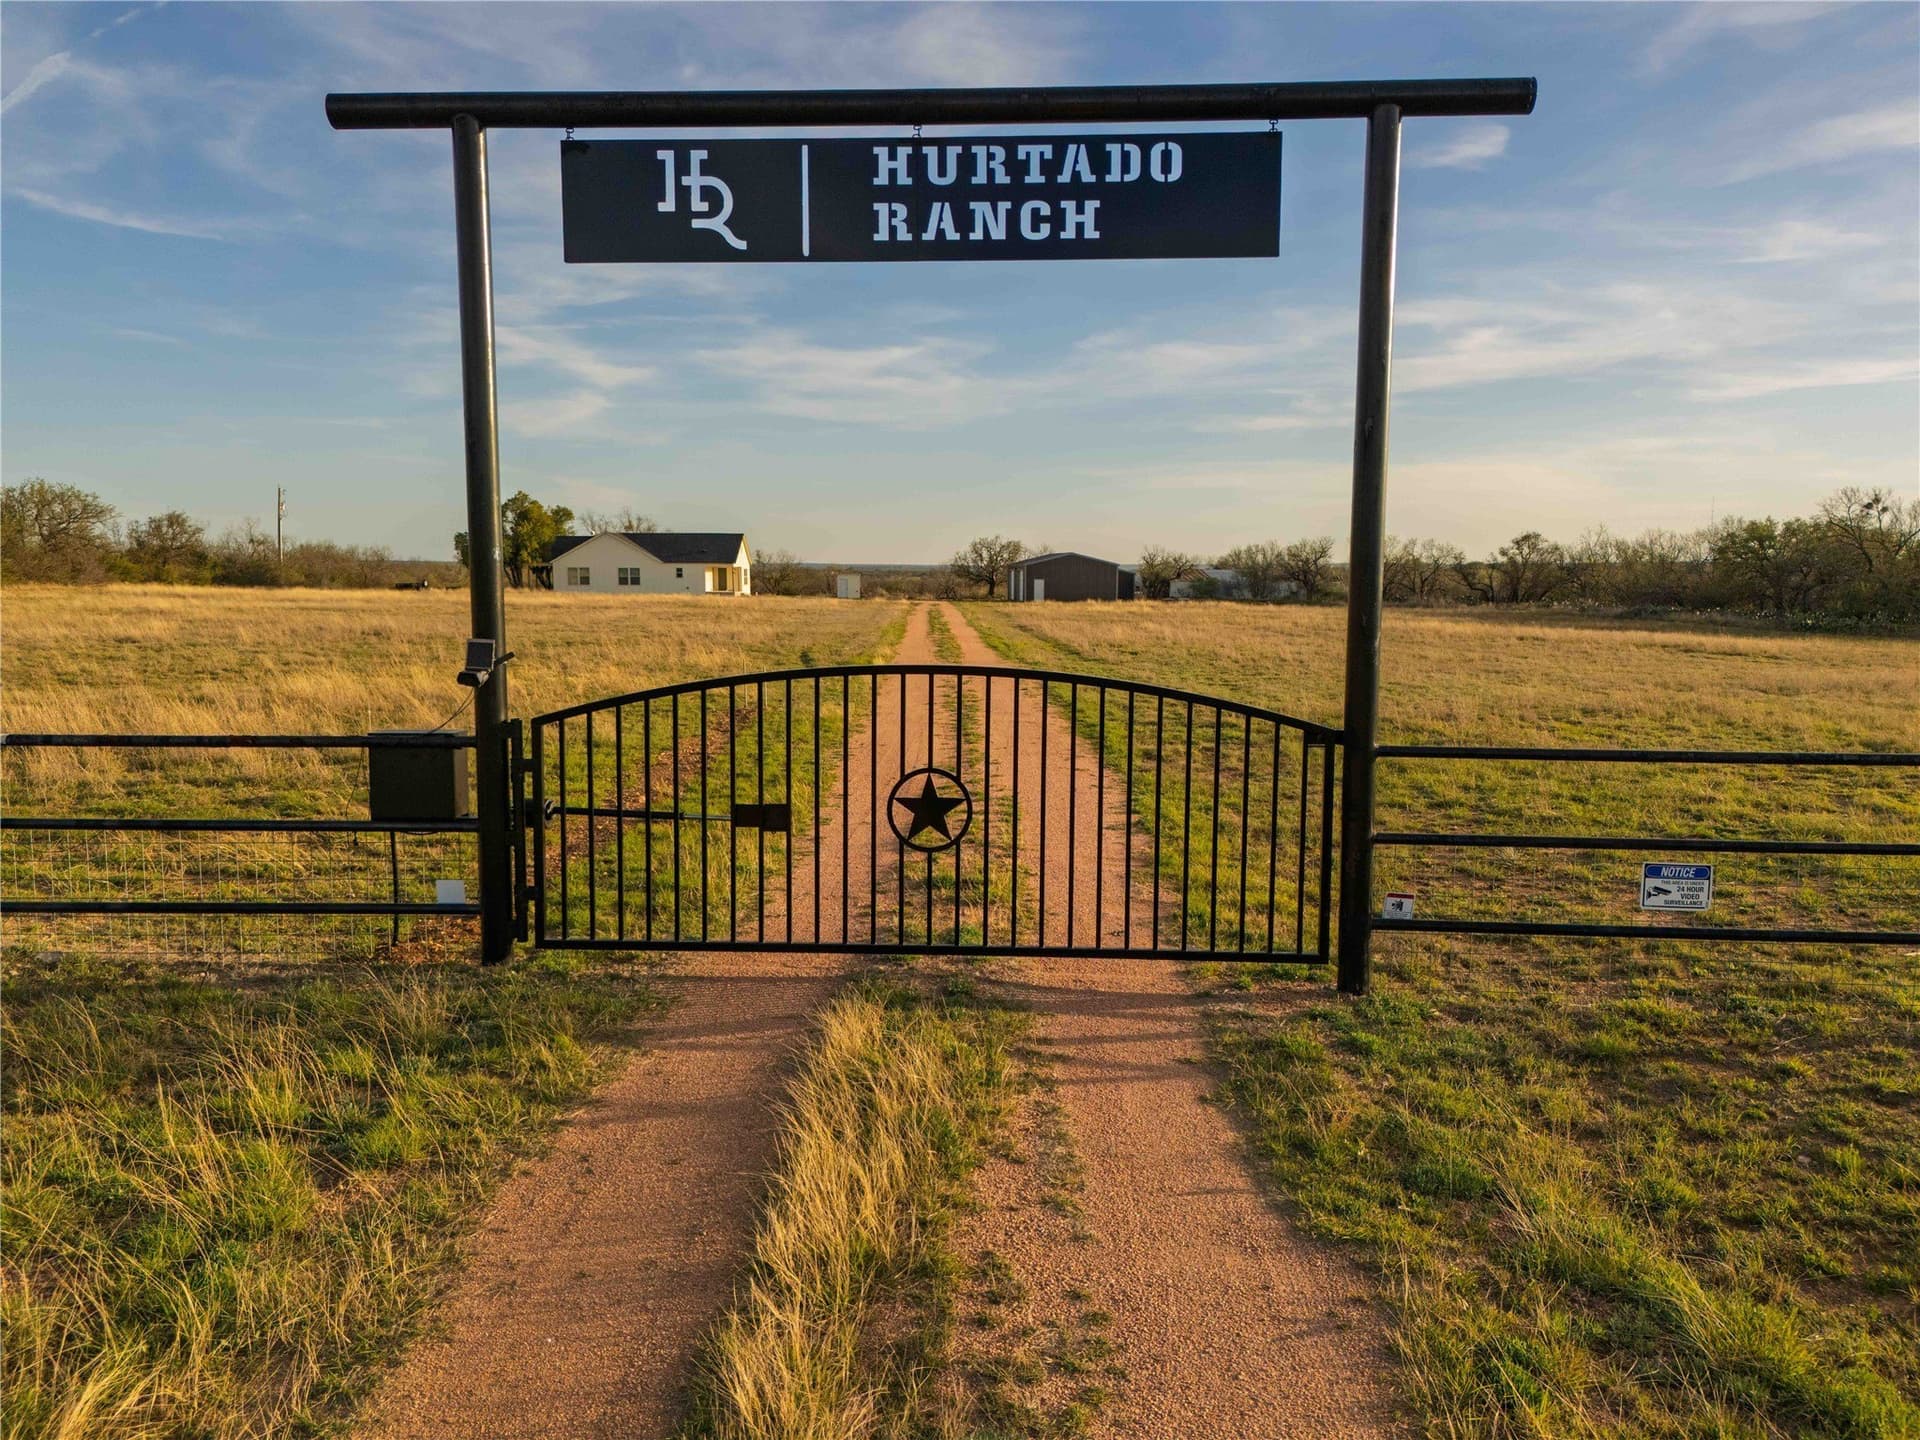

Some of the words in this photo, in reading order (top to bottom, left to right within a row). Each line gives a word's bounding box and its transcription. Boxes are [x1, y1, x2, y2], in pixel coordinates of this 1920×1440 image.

[872, 141, 1184, 186] HURTADO
[872, 199, 1102, 242] RANCH
[1661, 866, 1696, 878] NOTICE
